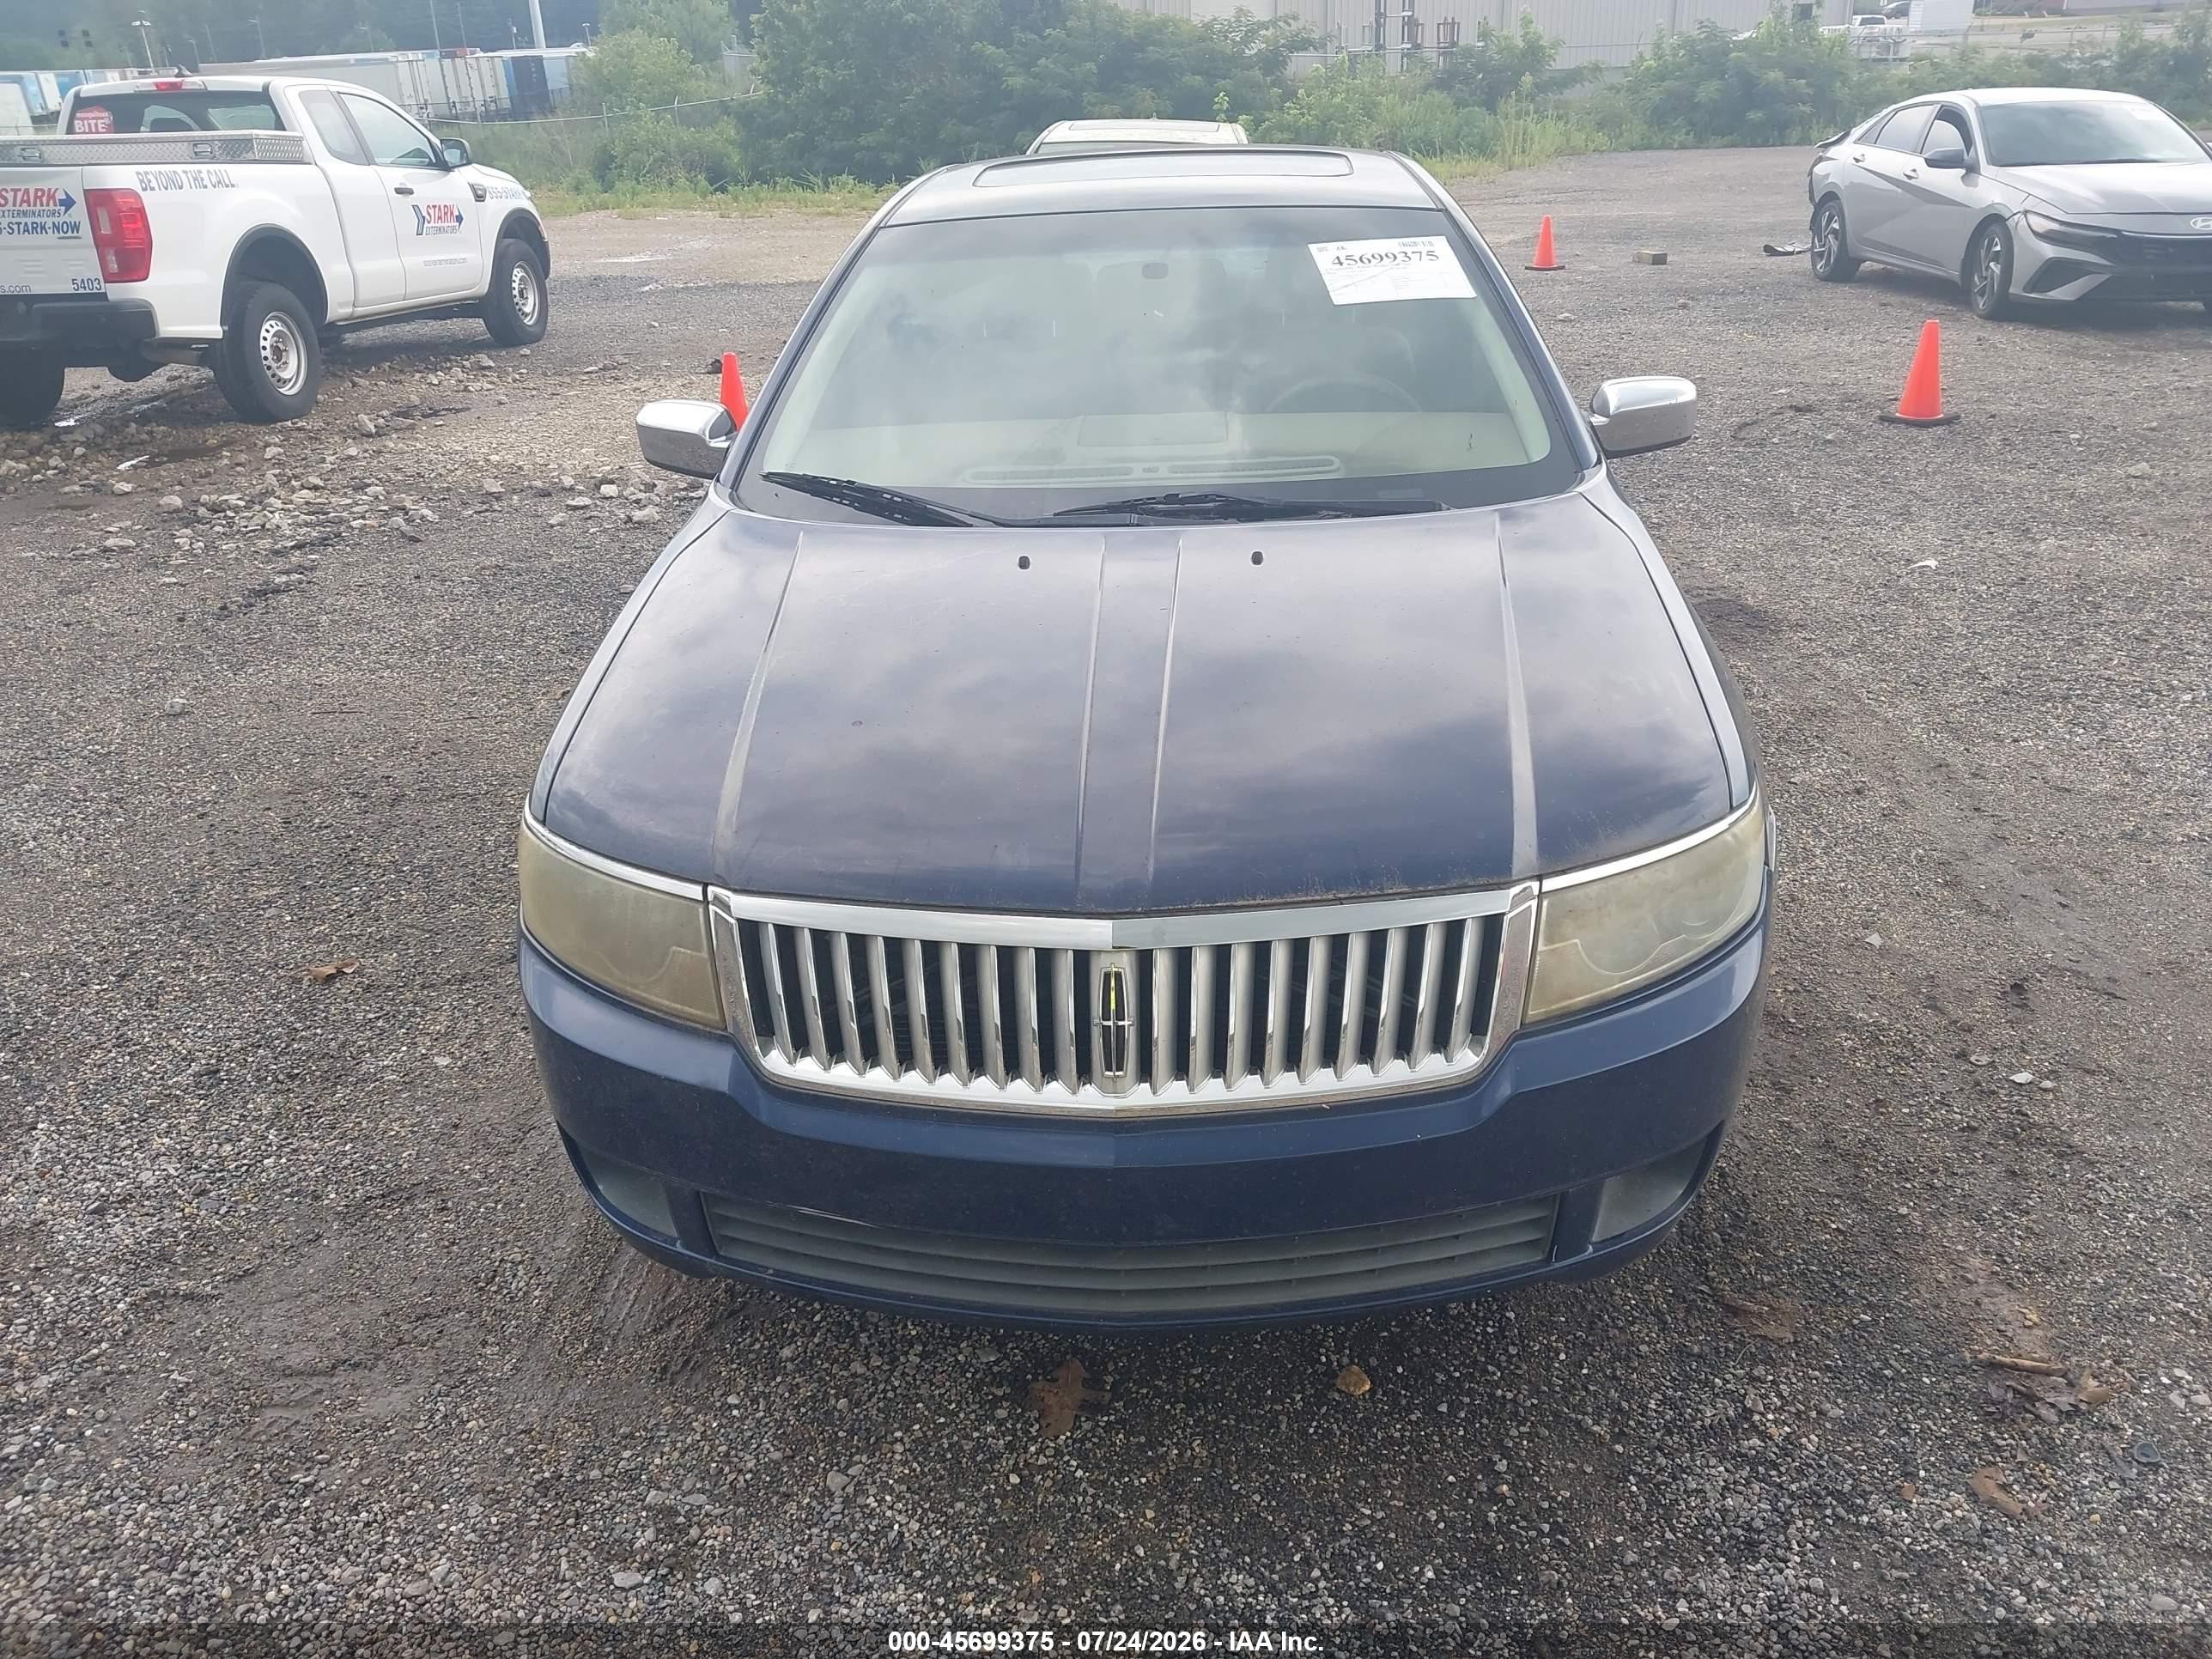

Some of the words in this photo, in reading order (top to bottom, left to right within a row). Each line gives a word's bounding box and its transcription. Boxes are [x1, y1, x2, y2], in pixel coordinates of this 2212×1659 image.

[74, 119, 106, 132] BITE
[135, 171, 184, 191] BEYOND
[181, 169, 208, 190] THE
[206, 169, 235, 189] CALL
[0, 188, 58, 207] STARK
[426, 204, 455, 224] STARK
[1332, 251, 1439, 266] 45699375
[71, 277, 101, 291] 5403
